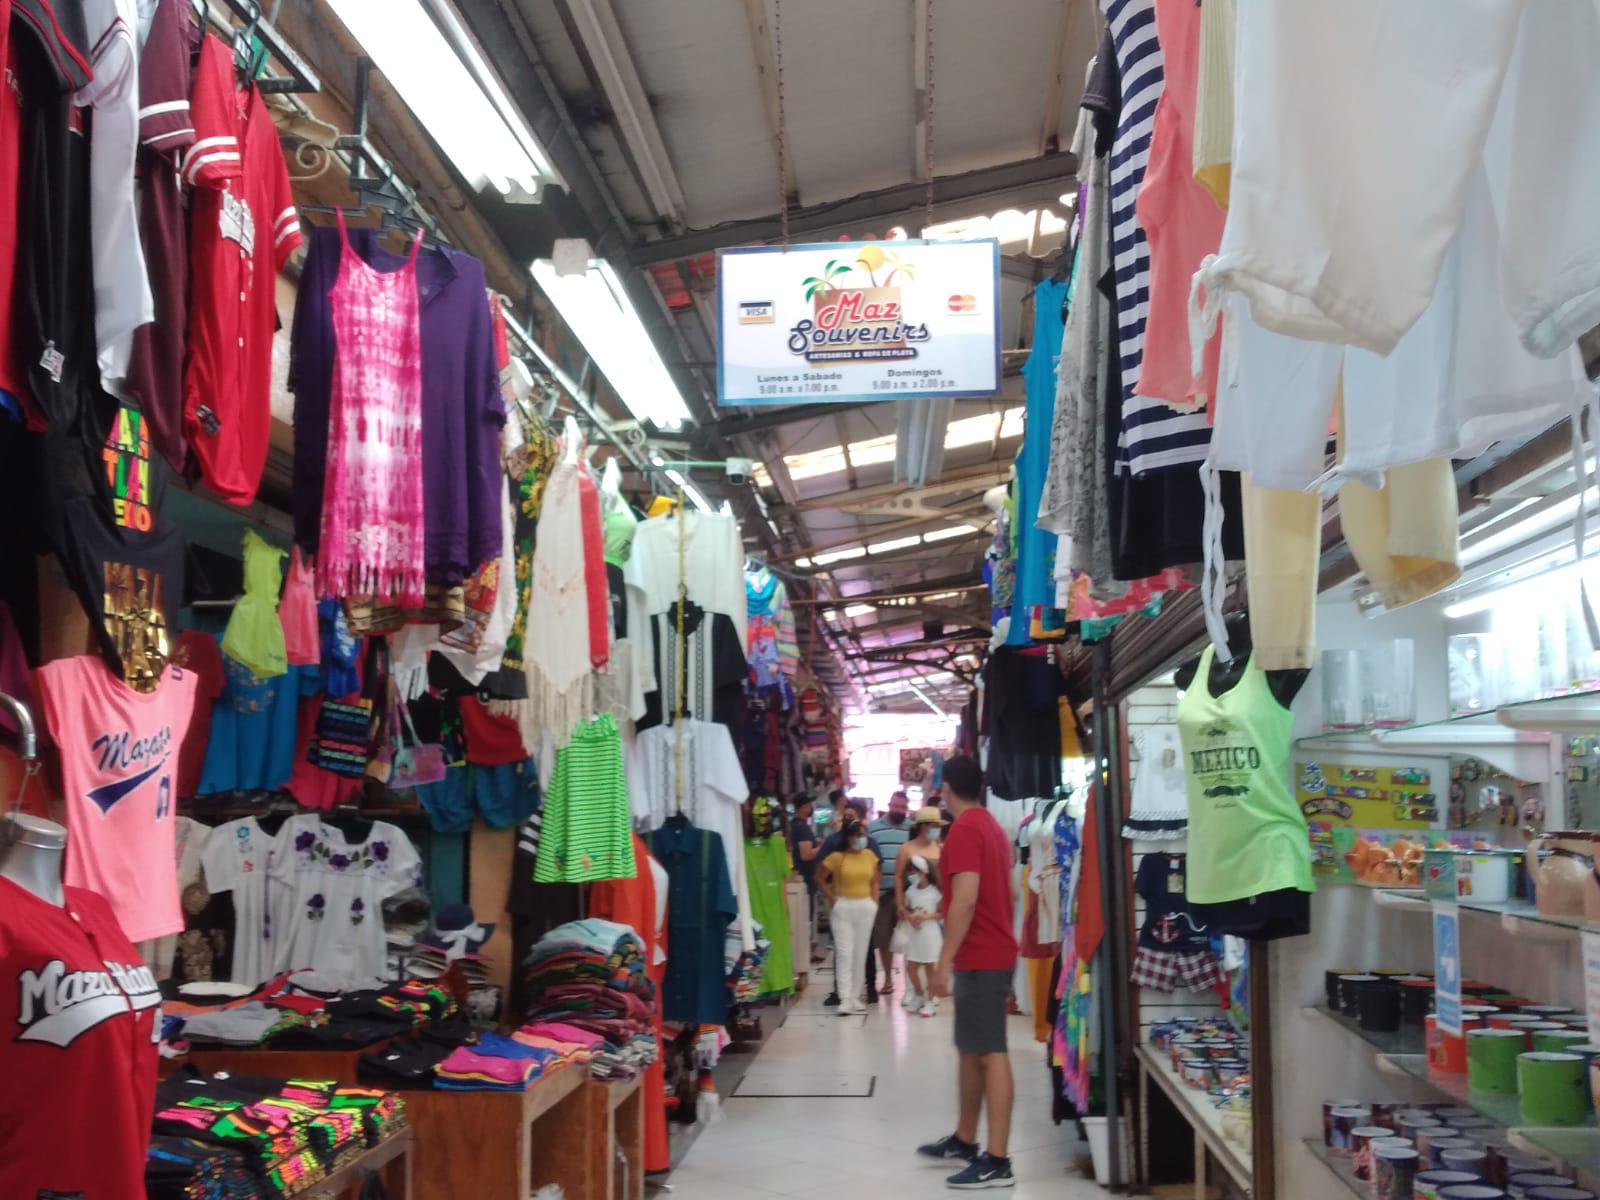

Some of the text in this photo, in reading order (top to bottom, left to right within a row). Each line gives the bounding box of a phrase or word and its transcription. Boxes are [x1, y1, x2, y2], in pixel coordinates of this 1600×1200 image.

[746, 308, 768, 316] VISA
[817, 291, 899, 329] Maz
[788, 319, 930, 352] Souvenirs
[757, 374, 789, 383] Lunes
[887, 368, 942, 378] Domingos
[1190, 747, 1260, 774] MEXICO
